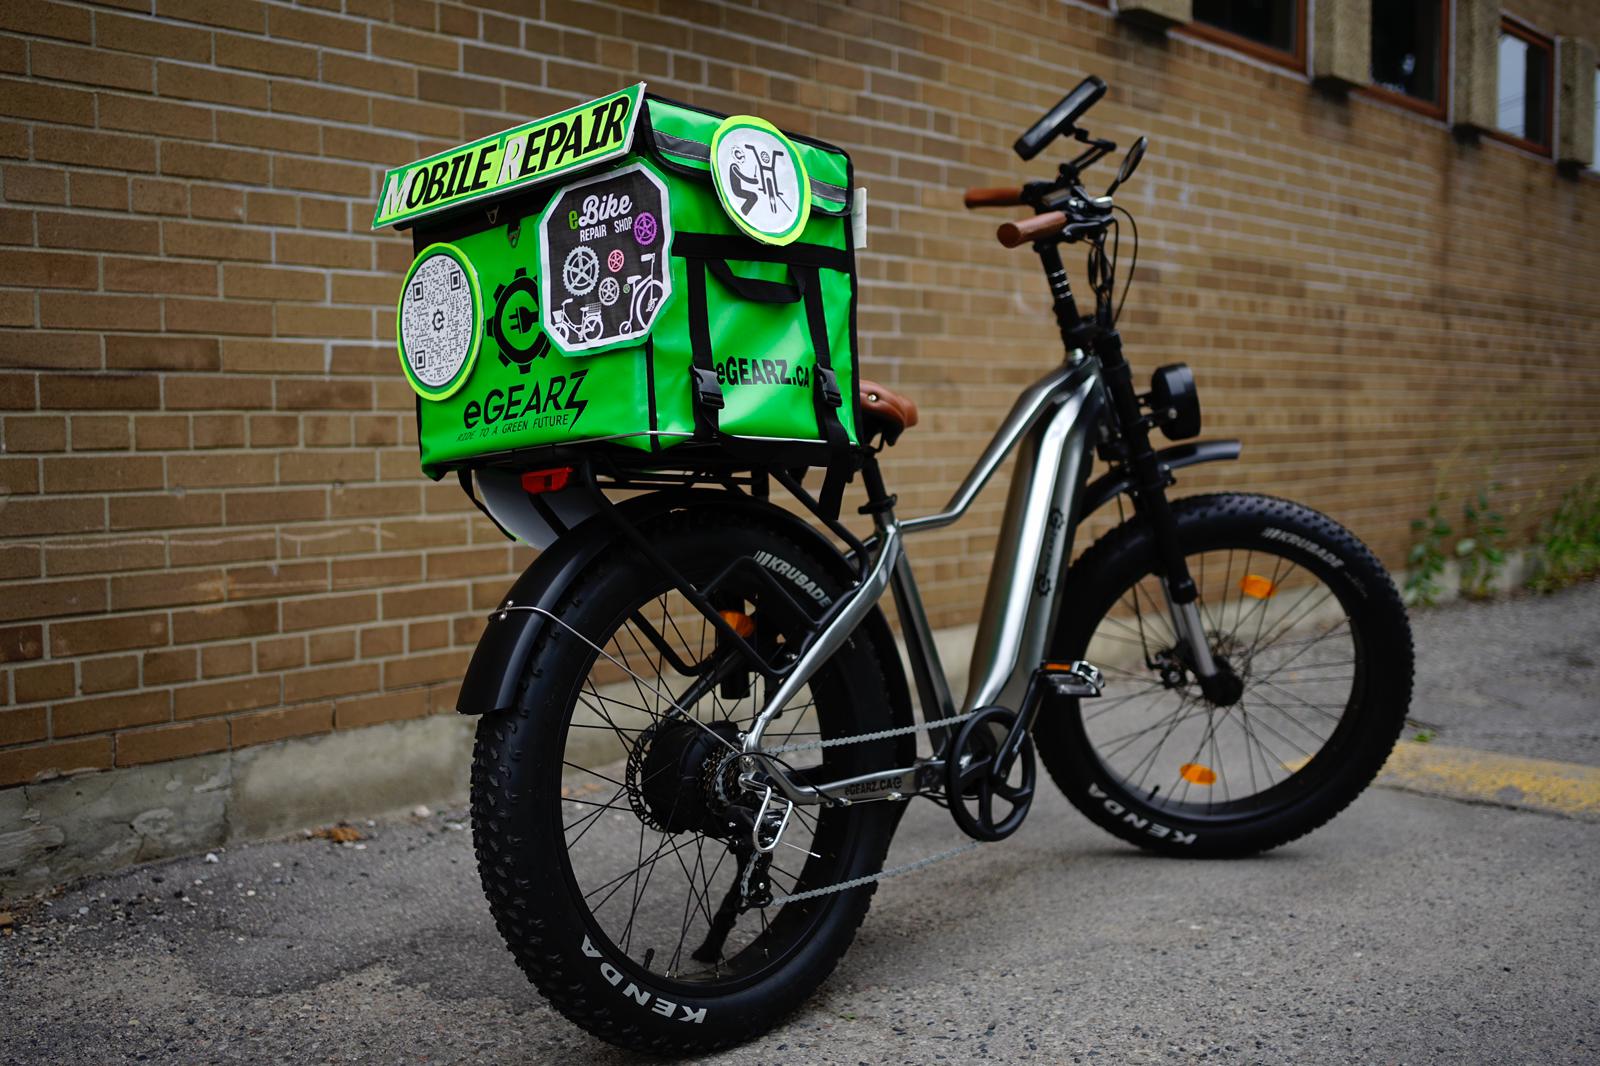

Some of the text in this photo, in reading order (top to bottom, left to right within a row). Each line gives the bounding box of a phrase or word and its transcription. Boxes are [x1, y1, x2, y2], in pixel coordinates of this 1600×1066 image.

[380, 96, 630, 218] MOBILE REPAIR
[569, 193, 633, 229] eBike
[580, 216, 633, 243] REPAIR SHOP
[716, 356, 810, 388] eGEARZ.CA
[463, 368, 589, 433] eGEARZ
[456, 414, 569, 442] RIDE TO A GREEN FUTURE
[766, 555, 833, 608] KRUSADE
[1088, 782, 1198, 845] KENDA
[581, 934, 708, 1024] KENDA
